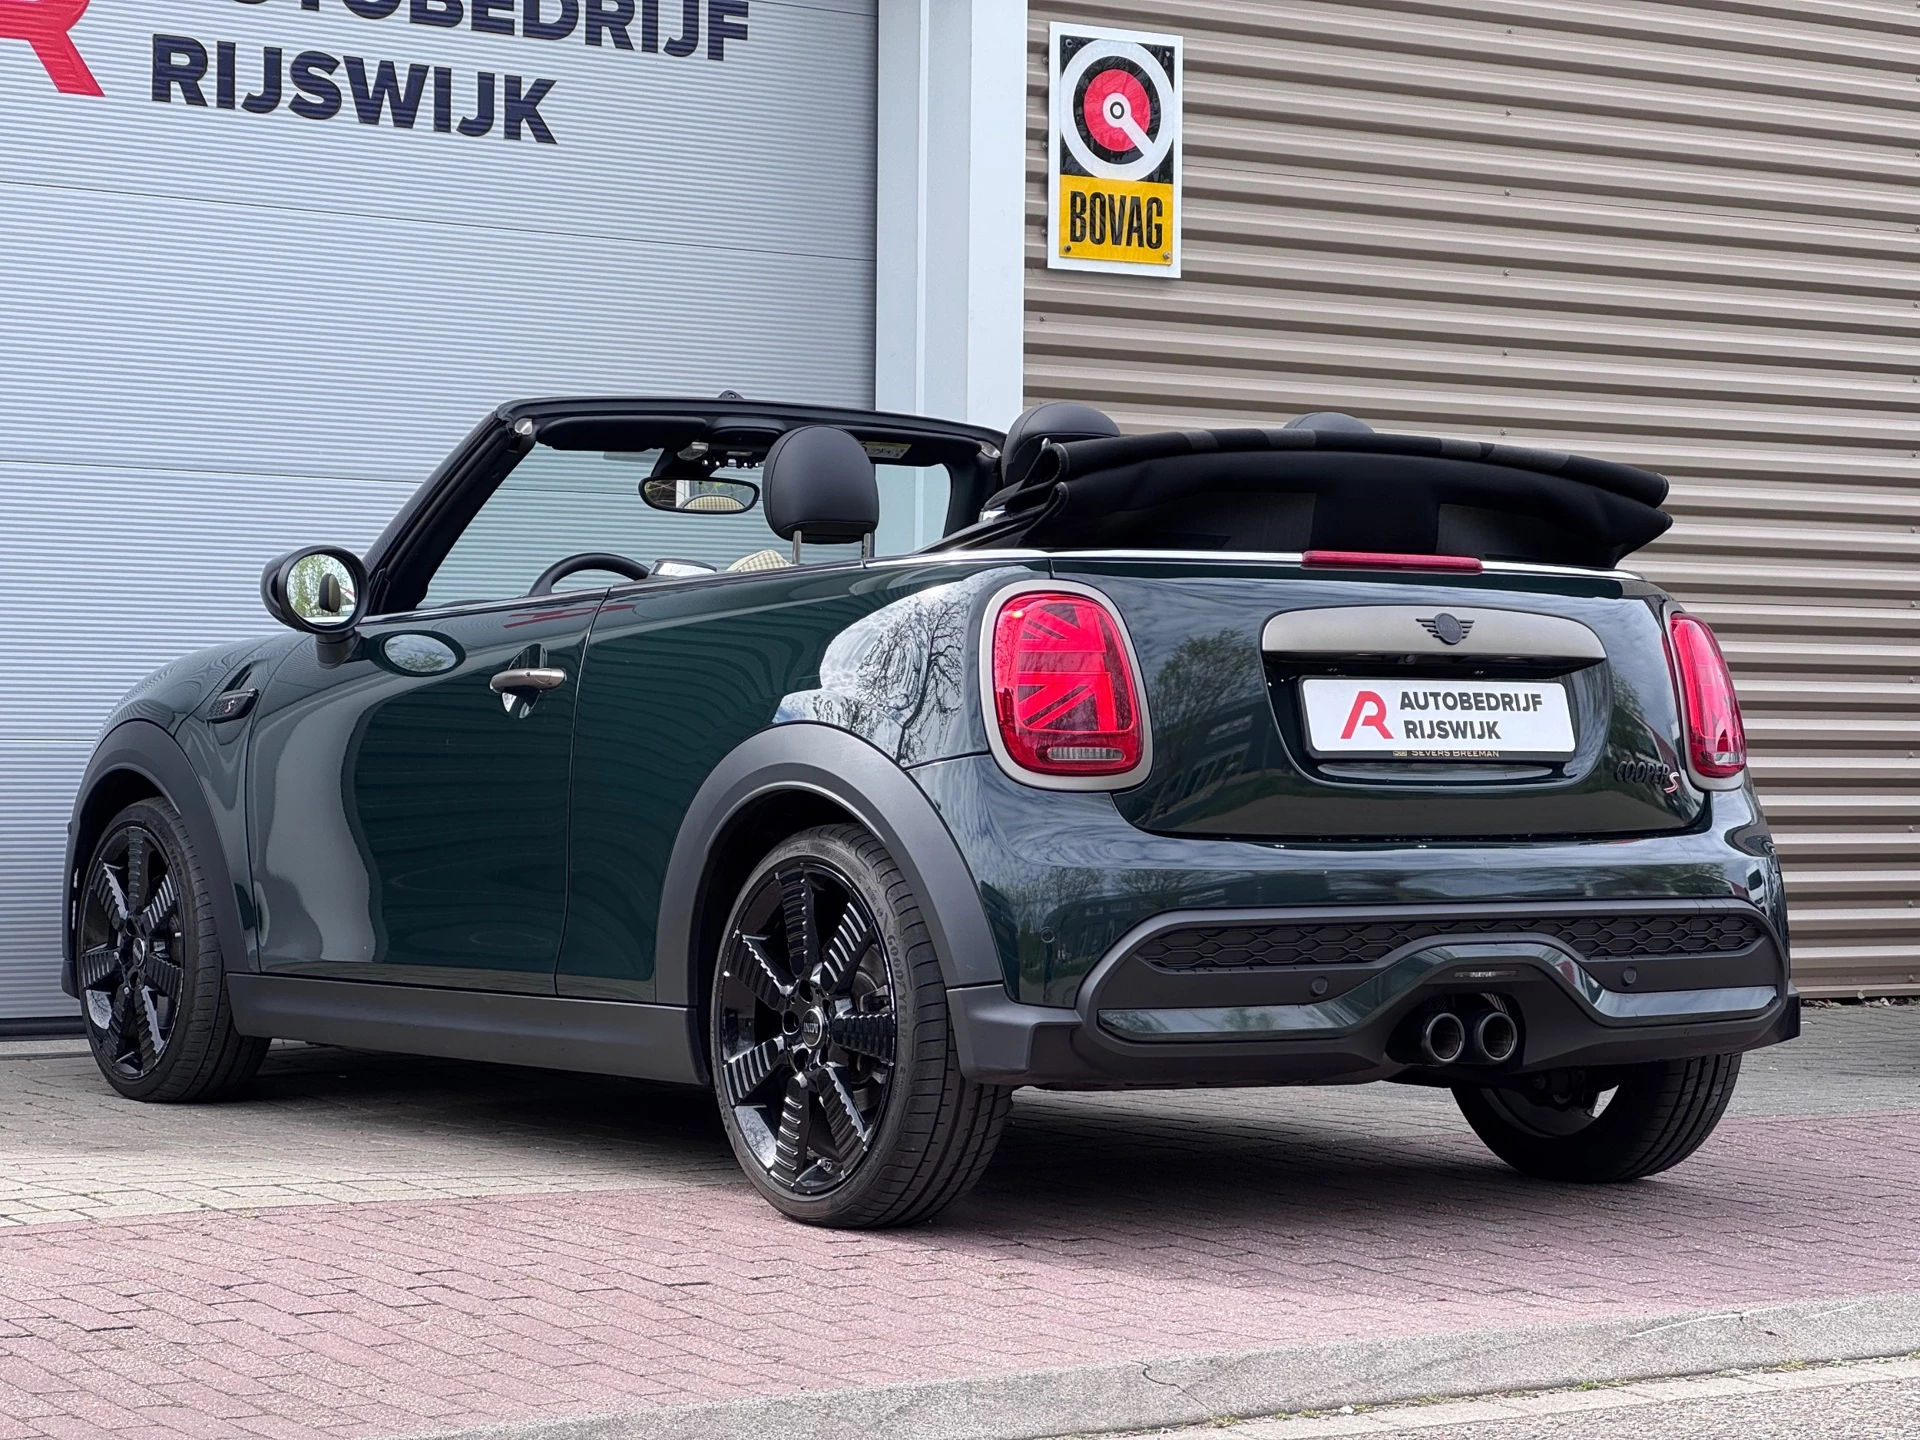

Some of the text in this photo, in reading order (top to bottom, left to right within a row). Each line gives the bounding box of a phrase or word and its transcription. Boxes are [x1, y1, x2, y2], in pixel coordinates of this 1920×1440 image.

[151, 33, 557, 145] RIJSWIJK
[1070, 190, 1163, 250] BOVAG
[1400, 691, 1543, 712] AUTOBEDRIJF
[1403, 720, 1502, 740] RIJSWIJK
[1616, 761, 1680, 794] COOPER S
[886, 934, 909, 1042] GOODYEAR
